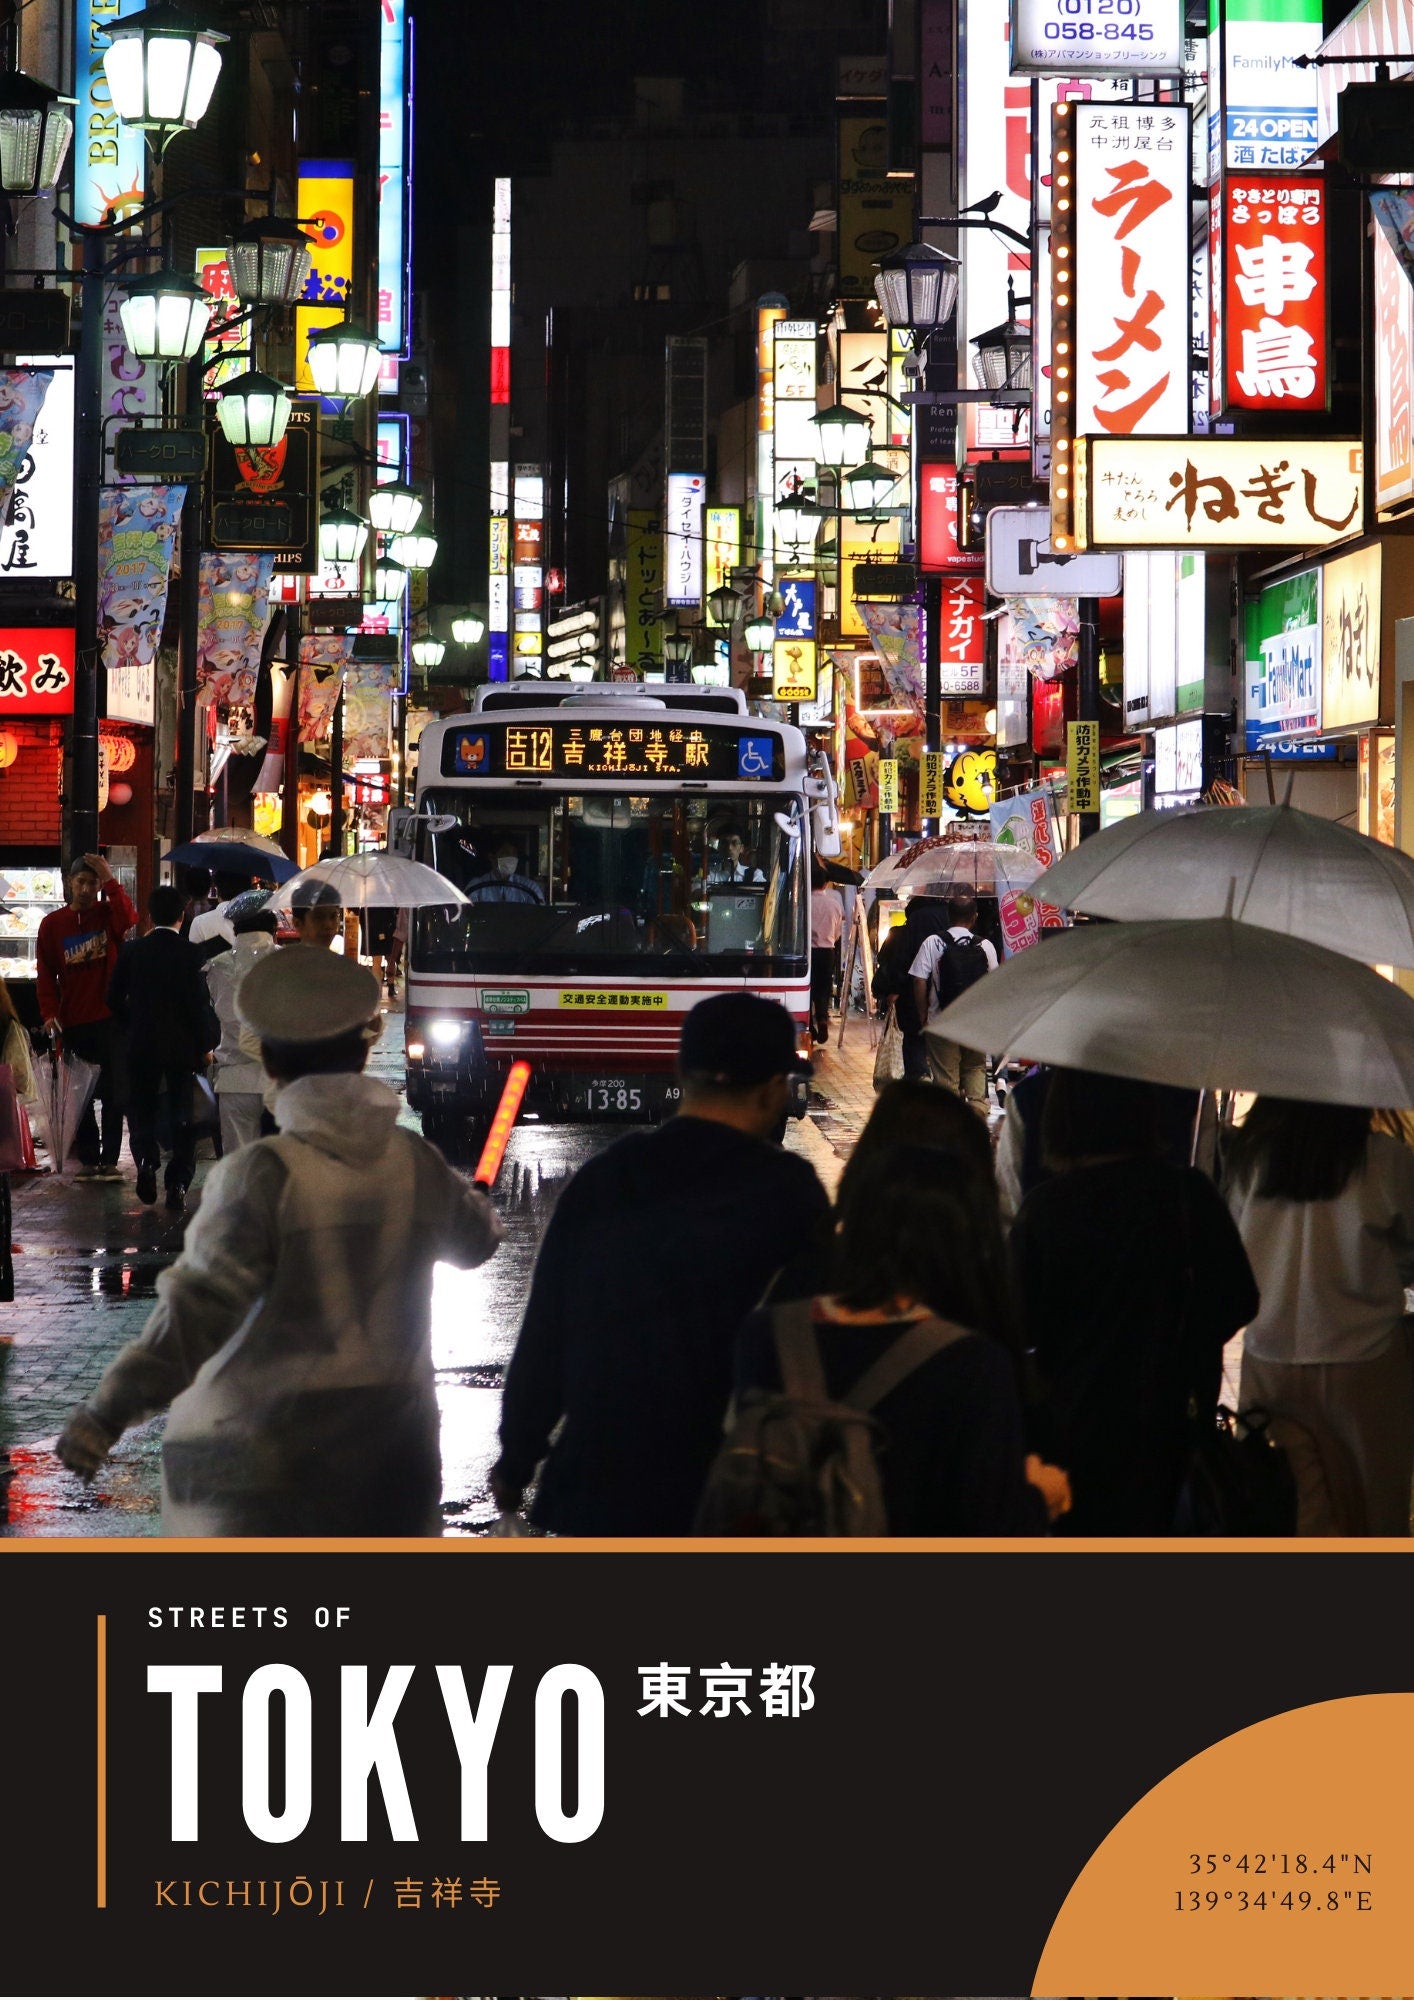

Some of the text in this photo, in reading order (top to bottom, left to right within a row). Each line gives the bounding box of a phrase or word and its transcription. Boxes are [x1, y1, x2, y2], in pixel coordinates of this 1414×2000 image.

[1044, 22, 1154, 41] 058-845
[1030, 49, 1168, 61] (株)アパマンショップリーシング
[1089, 115, 1176, 131] 元祖博多
[1091, 135, 1174, 151] 中洲屋台
[1234, 145, 1255, 164] 酒
[1232, 188, 1320, 205] やきとり専門
[1231, 205, 1321, 225] さっぽろ
[1091, 159, 1173, 434] ラーメン
[1234, 235, 1318, 399] 串鳥
[1100, 471, 1143, 487] 牛たん
[1124, 489, 1159, 503] とろろ
[1165, 458, 1359, 533] ねぎし
[1112, 507, 1148, 523] 麦めし
[115, 561, 147, 577] 2017
[784, 583, 813, 631] 大戸屋
[217, 620, 244, 630] 2017
[948, 578, 975, 661] スナガイ
[960, 665, 979, 677] 5F
[1266, 643, 1313, 708] FamilyMart
[568, 728, 703, 743] 三鷹台団地経由
[508, 730, 551, 767] 吉12
[561, 743, 710, 767] 吉祥寺駅
[1075, 724, 1091, 810] 防犯カメラ作動中
[883, 761, 893, 811] 防犯カメラ作動中
[925, 754, 937, 815] 防犯カメラ作動中
[563, 993, 663, 1006] 交通安全運動実施中
[586, 1088, 641, 1110] 13-85
